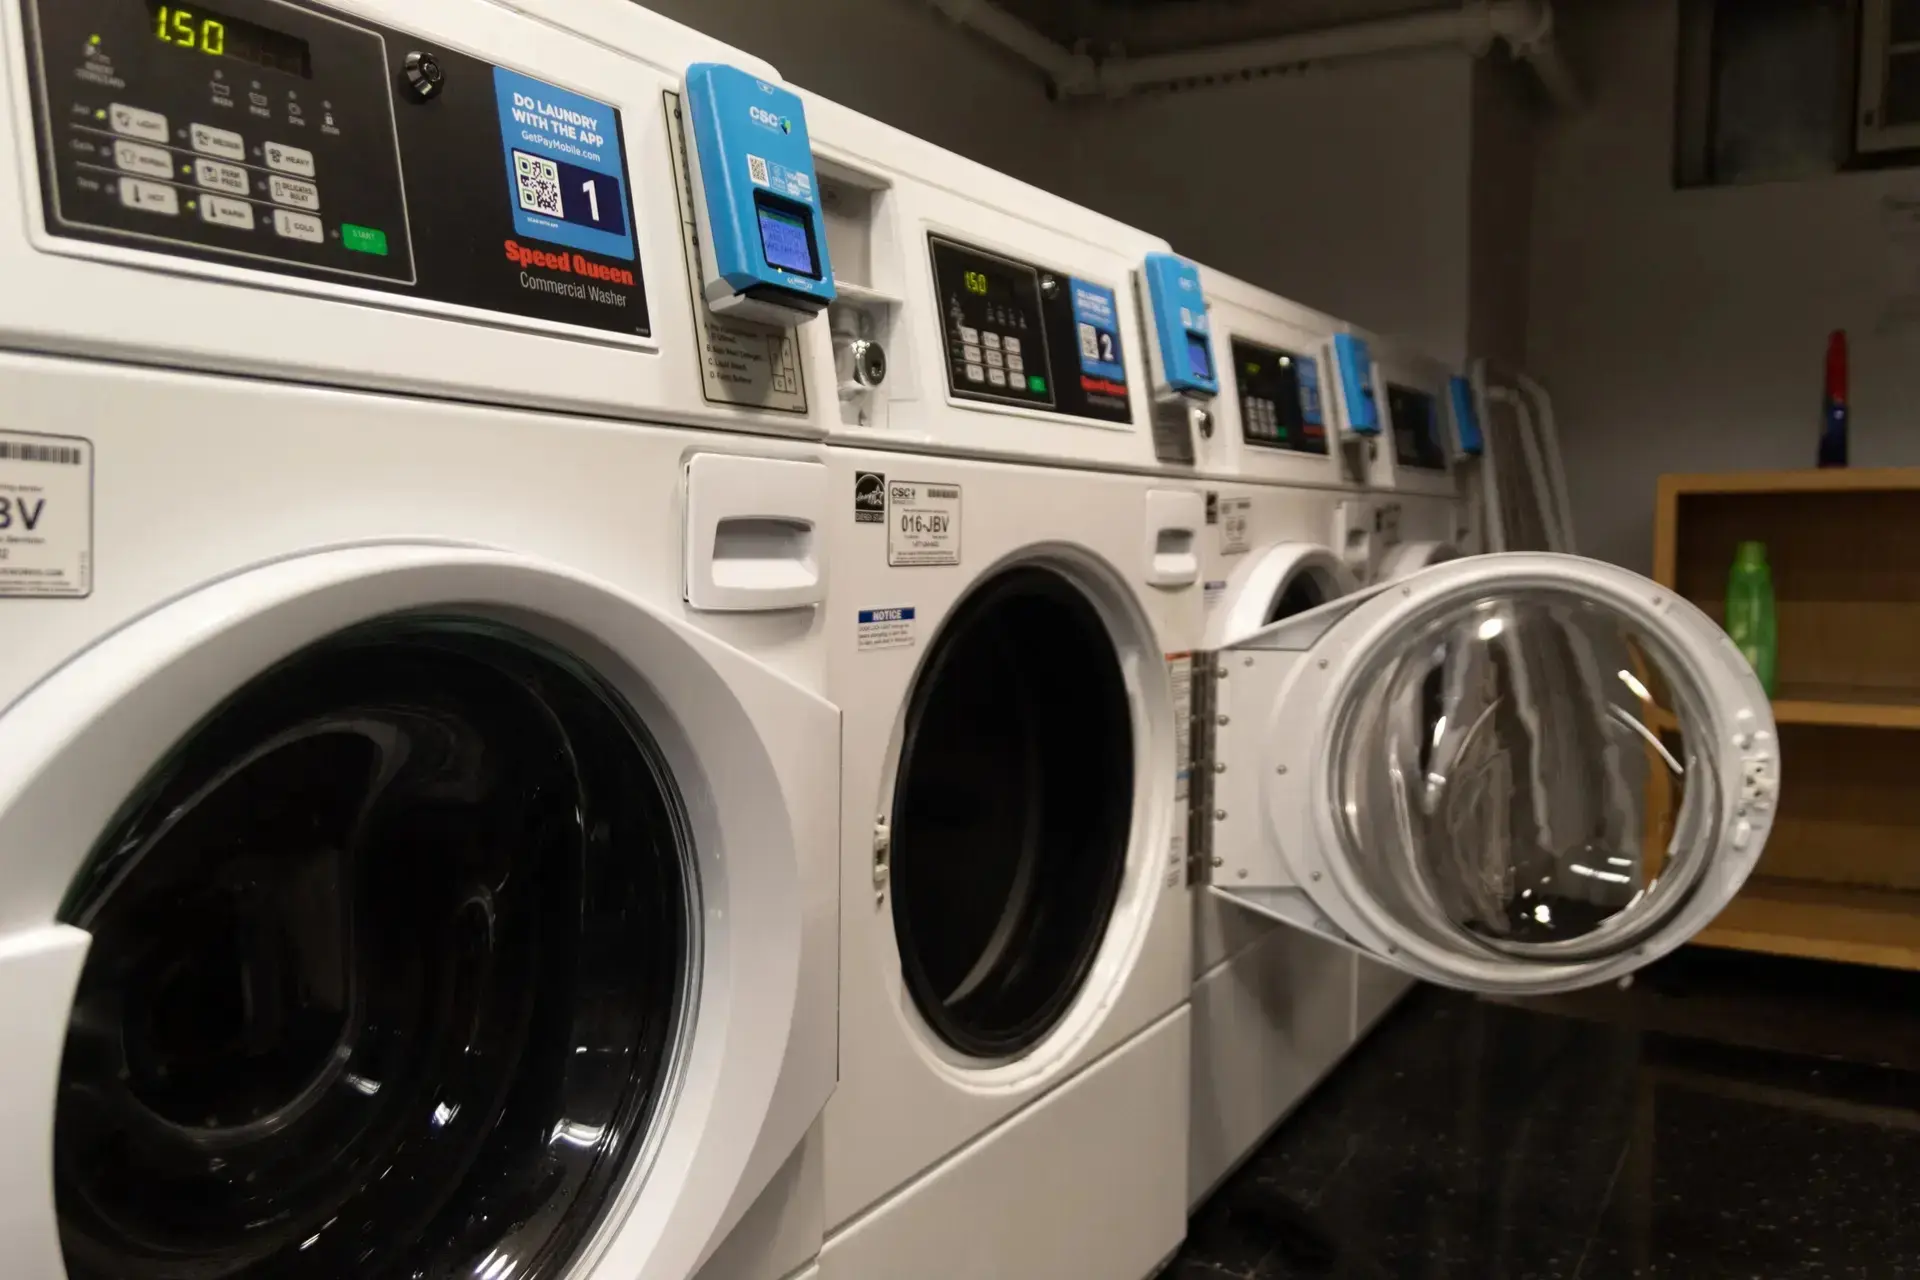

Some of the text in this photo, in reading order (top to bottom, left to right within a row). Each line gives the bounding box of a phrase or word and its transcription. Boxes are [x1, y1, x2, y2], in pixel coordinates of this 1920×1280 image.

[157, 5, 224, 56] 1.50
[513, 92, 598, 131] DO LAUNDRY
[749, 105, 778, 128] CSC
[511, 107, 604, 147] WITH THE APP
[521, 130, 601, 162] GetPayMobile.com
[286, 155, 309, 167] HEAVY
[582, 179, 600, 222] 1
[294, 222, 314, 233] COLD
[352, 229, 375, 241] START
[504, 239, 634, 285] Speed Queen
[520, 271, 627, 307] Commercial Washer
[1100, 333, 1114, 362] 2
[891, 487, 911, 498] CSC
[901, 514, 949, 533] 016-JBV
[872, 609, 902, 621] NOTICE
